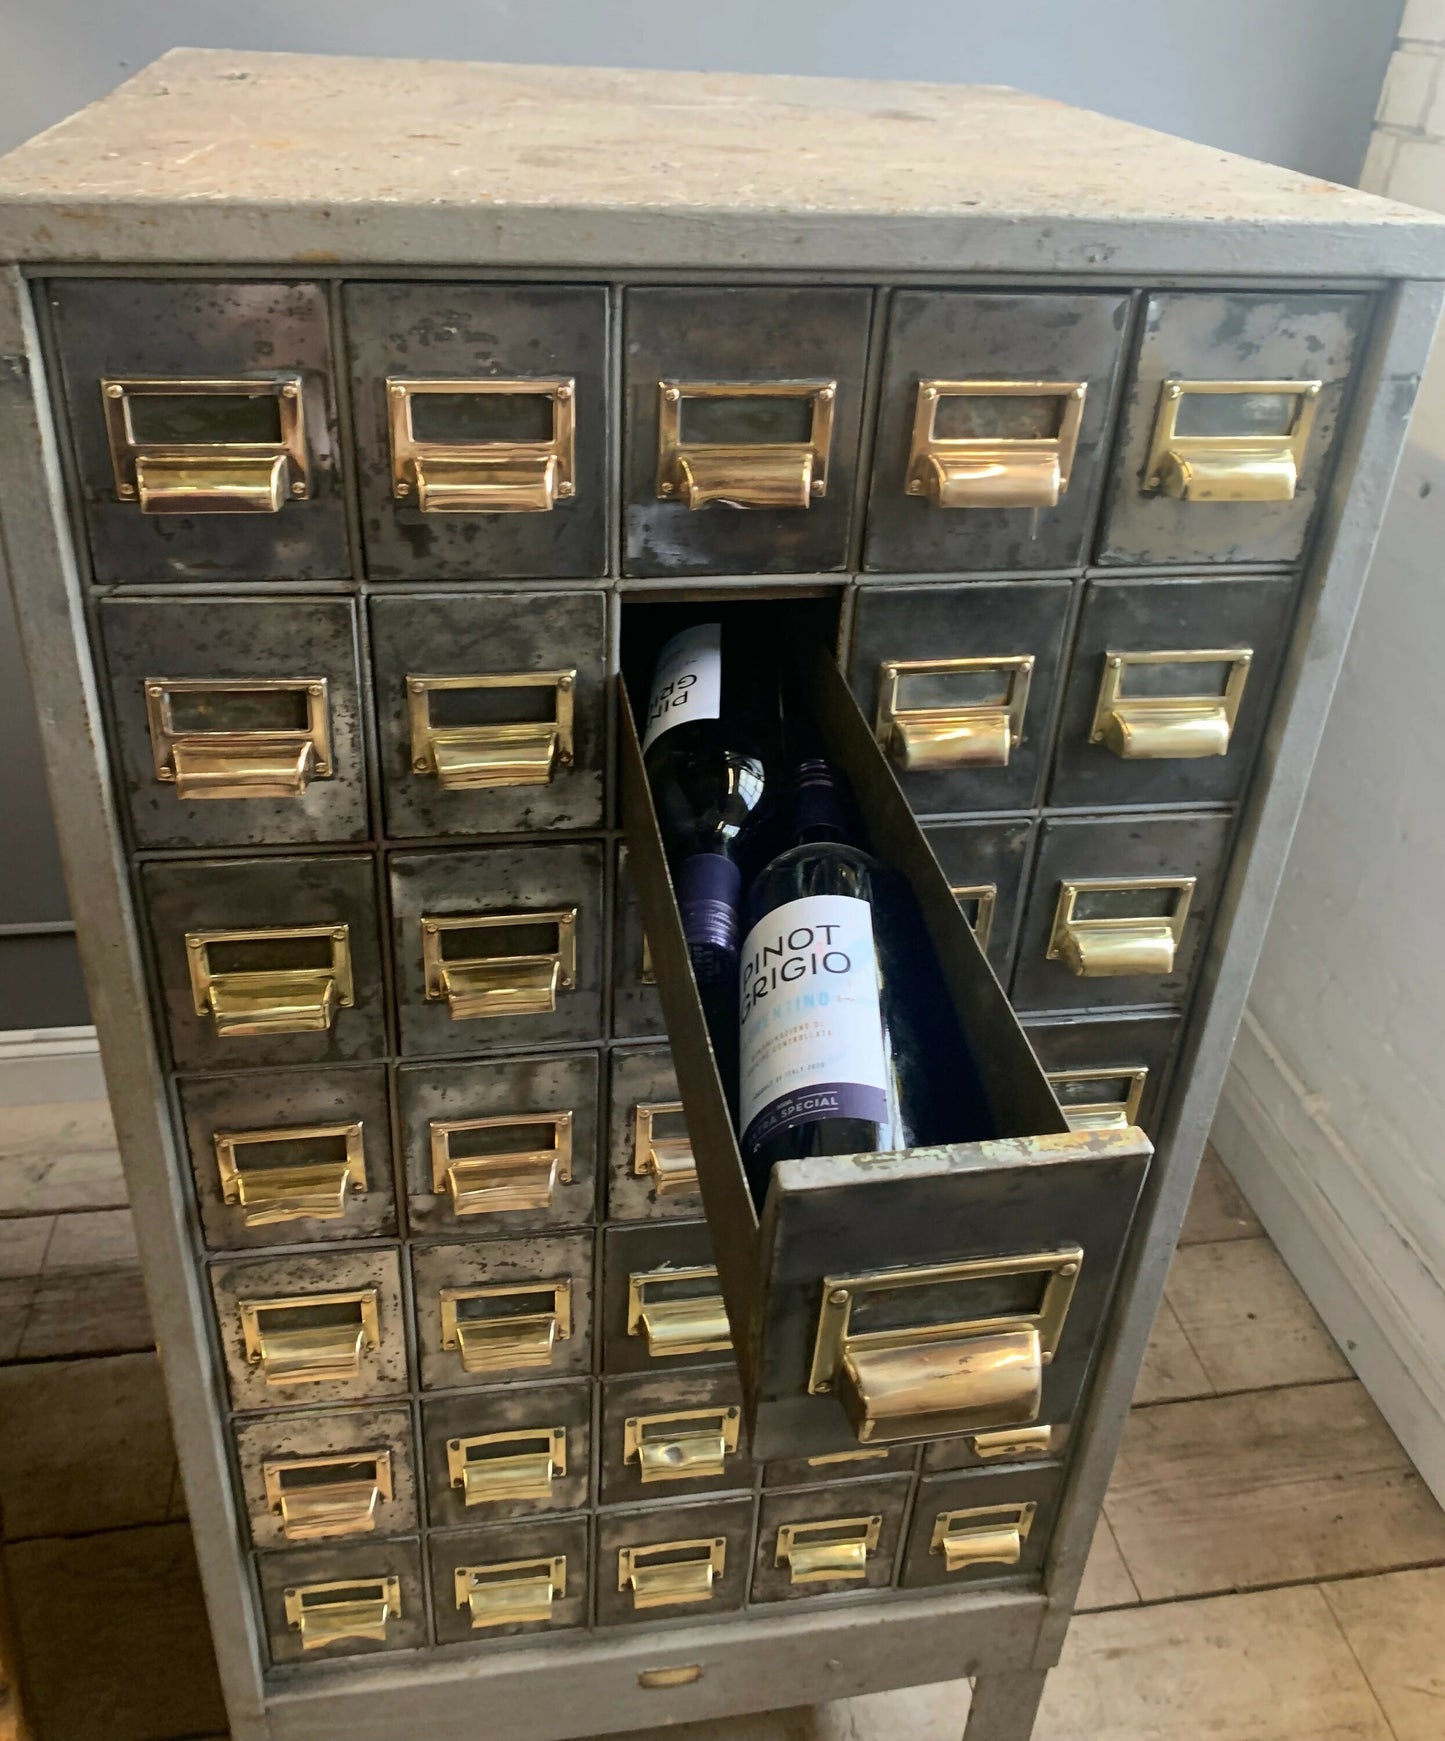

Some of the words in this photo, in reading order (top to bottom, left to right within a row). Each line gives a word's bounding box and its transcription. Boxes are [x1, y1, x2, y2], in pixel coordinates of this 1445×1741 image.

[741, 951, 851, 1025] GRIGIO
[743, 924, 841, 991] PINOT
[780, 1096, 839, 1119] SPECIAL
